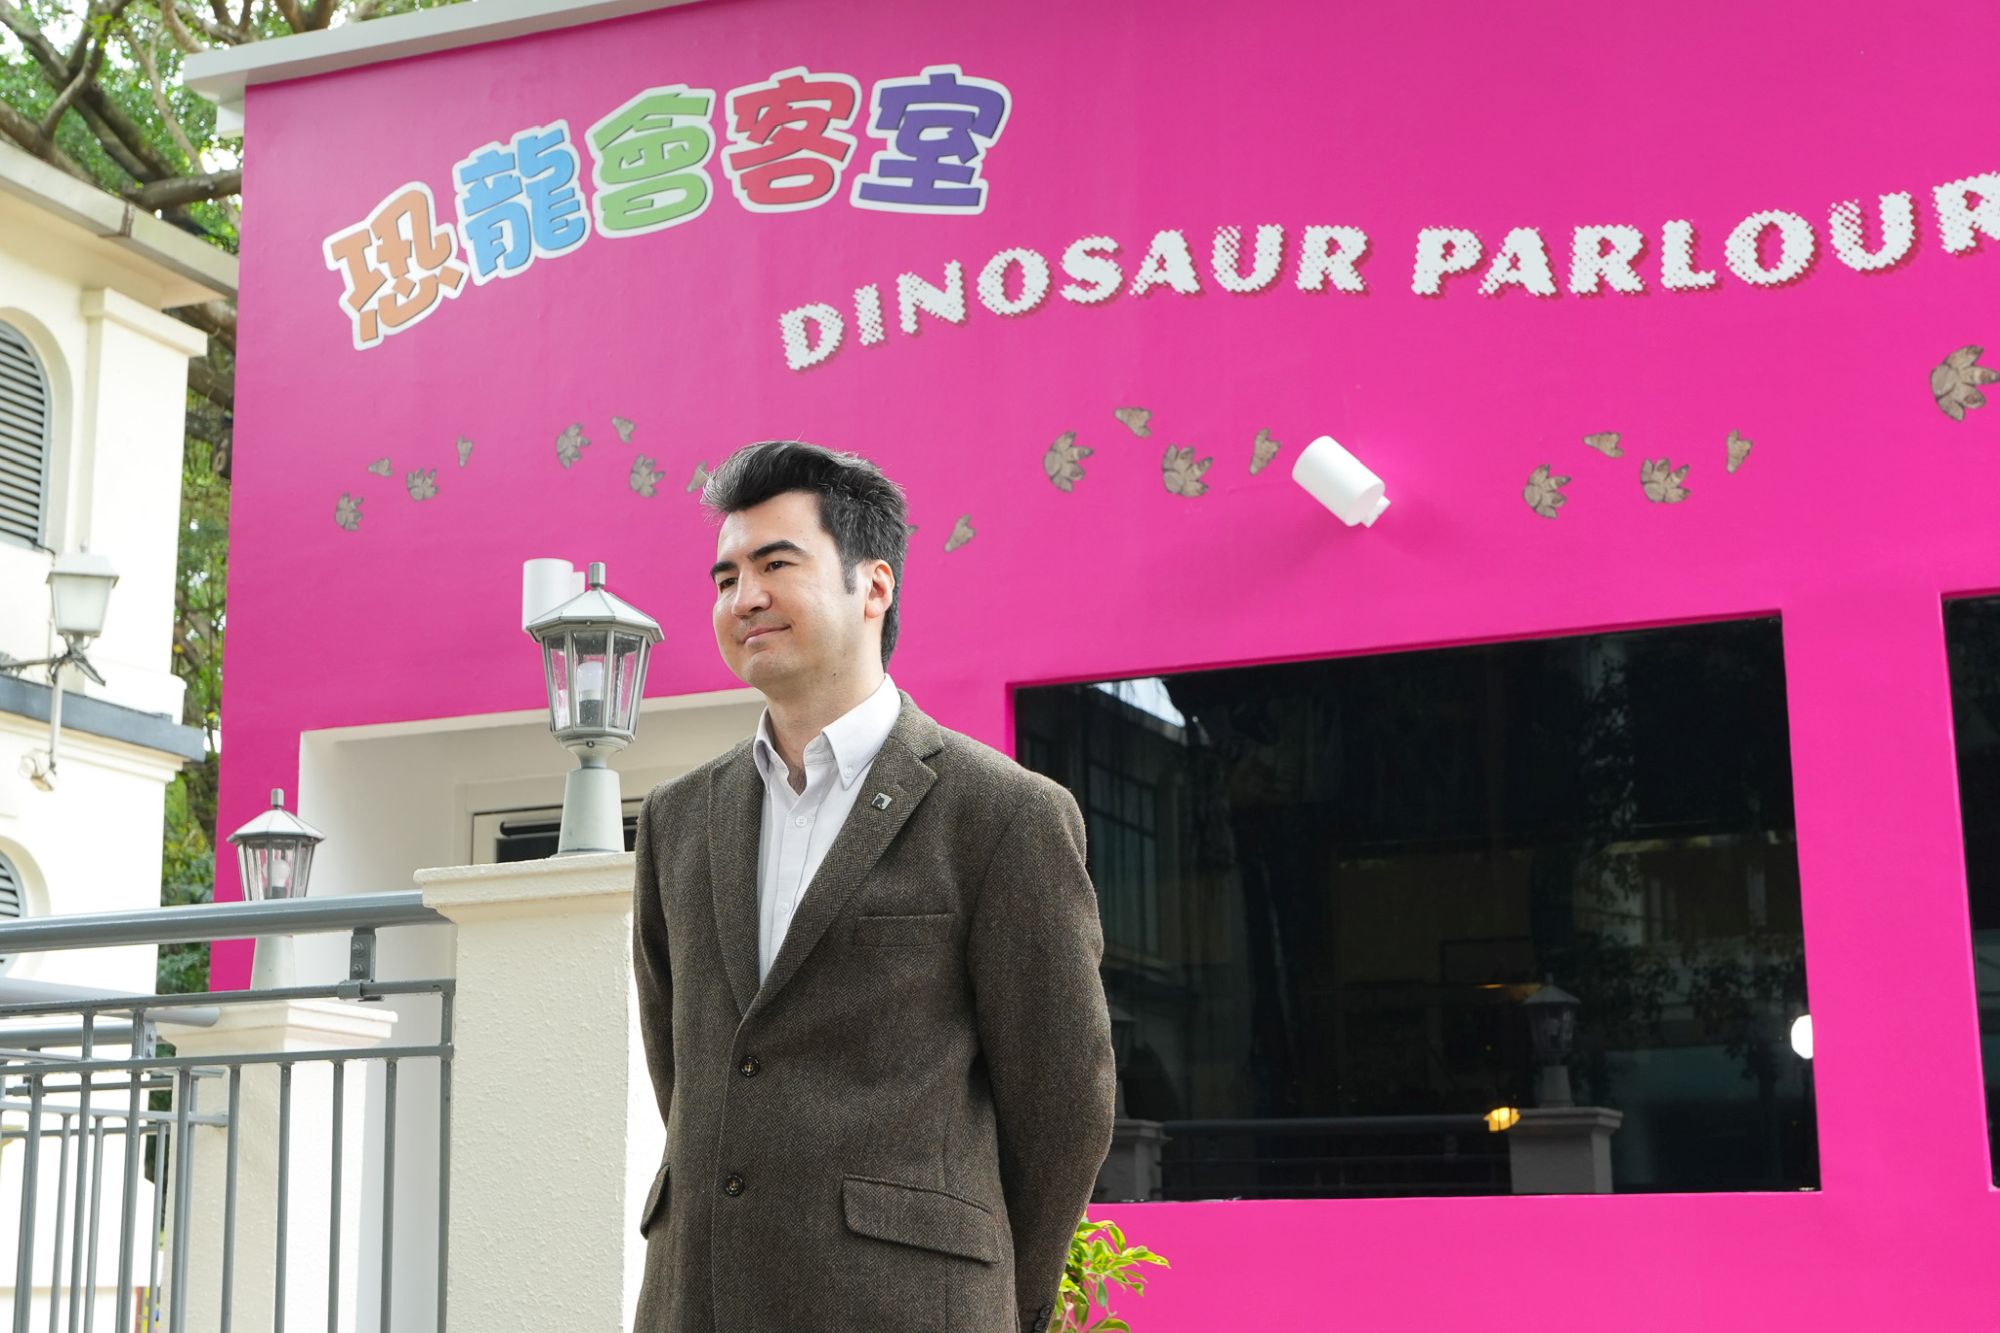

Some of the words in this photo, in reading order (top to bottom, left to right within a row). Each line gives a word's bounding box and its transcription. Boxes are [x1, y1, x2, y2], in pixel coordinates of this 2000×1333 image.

[326, 66, 1010, 348] 恐龍會客室
[779, 223, 1370, 371] DINOSAUR
[1411, 170, 2000, 296] PARLOUR
